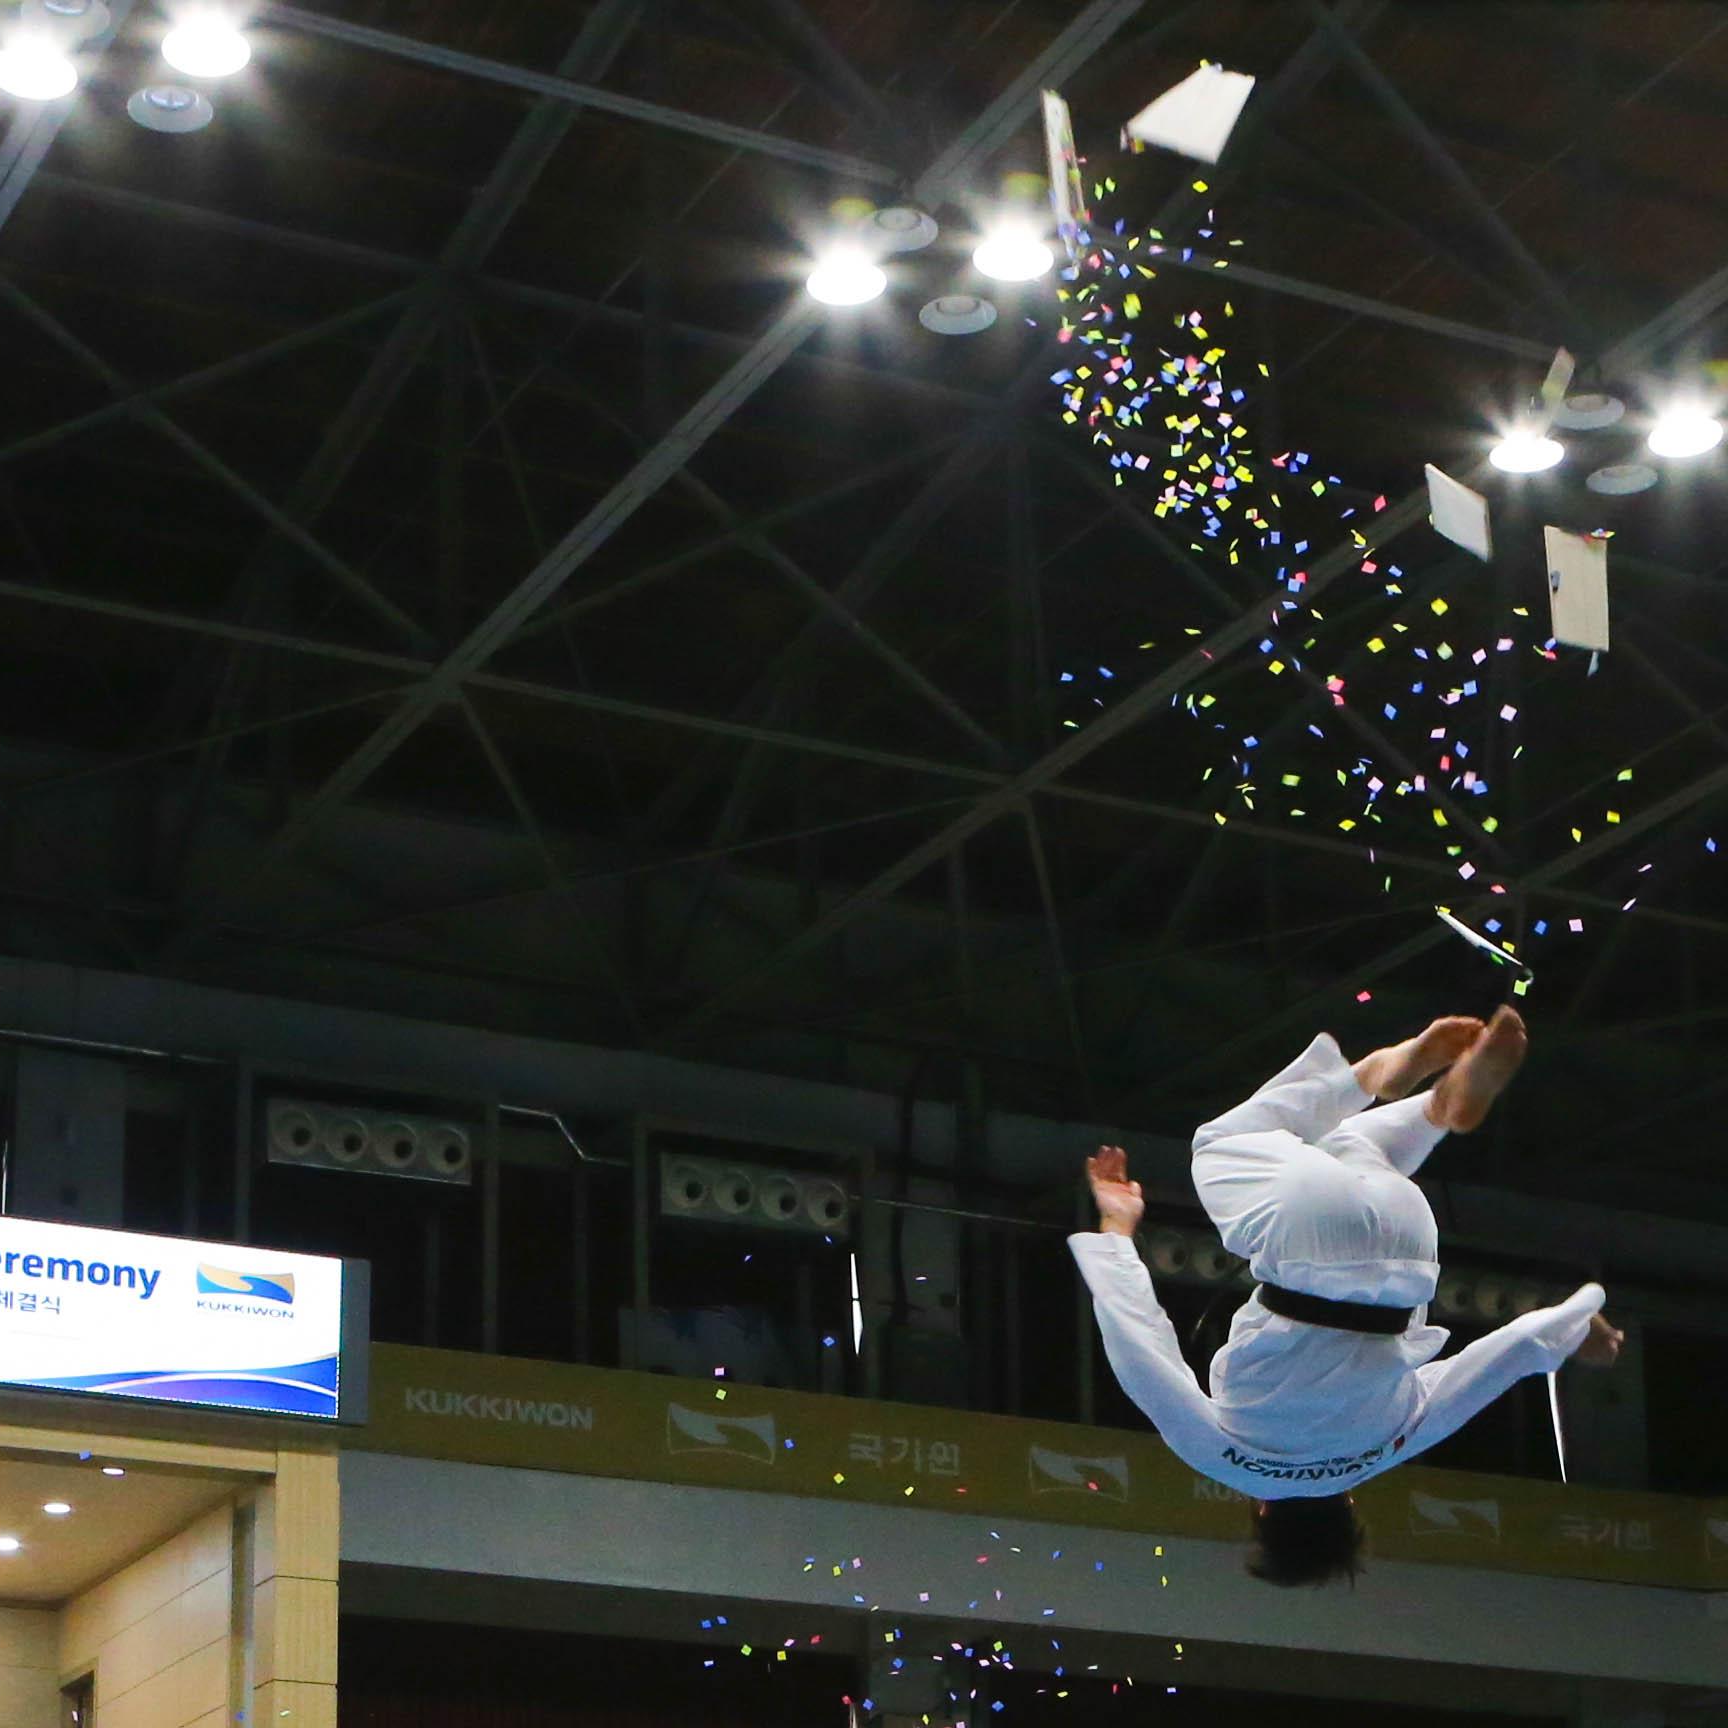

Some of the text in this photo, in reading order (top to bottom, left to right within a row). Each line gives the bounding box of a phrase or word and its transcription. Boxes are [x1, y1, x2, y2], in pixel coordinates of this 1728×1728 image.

[196, 1300, 294, 1319] KUKKIWON
[404, 1387, 593, 1432] KUKKIWON
[848, 1432, 961, 1477] 국기원
